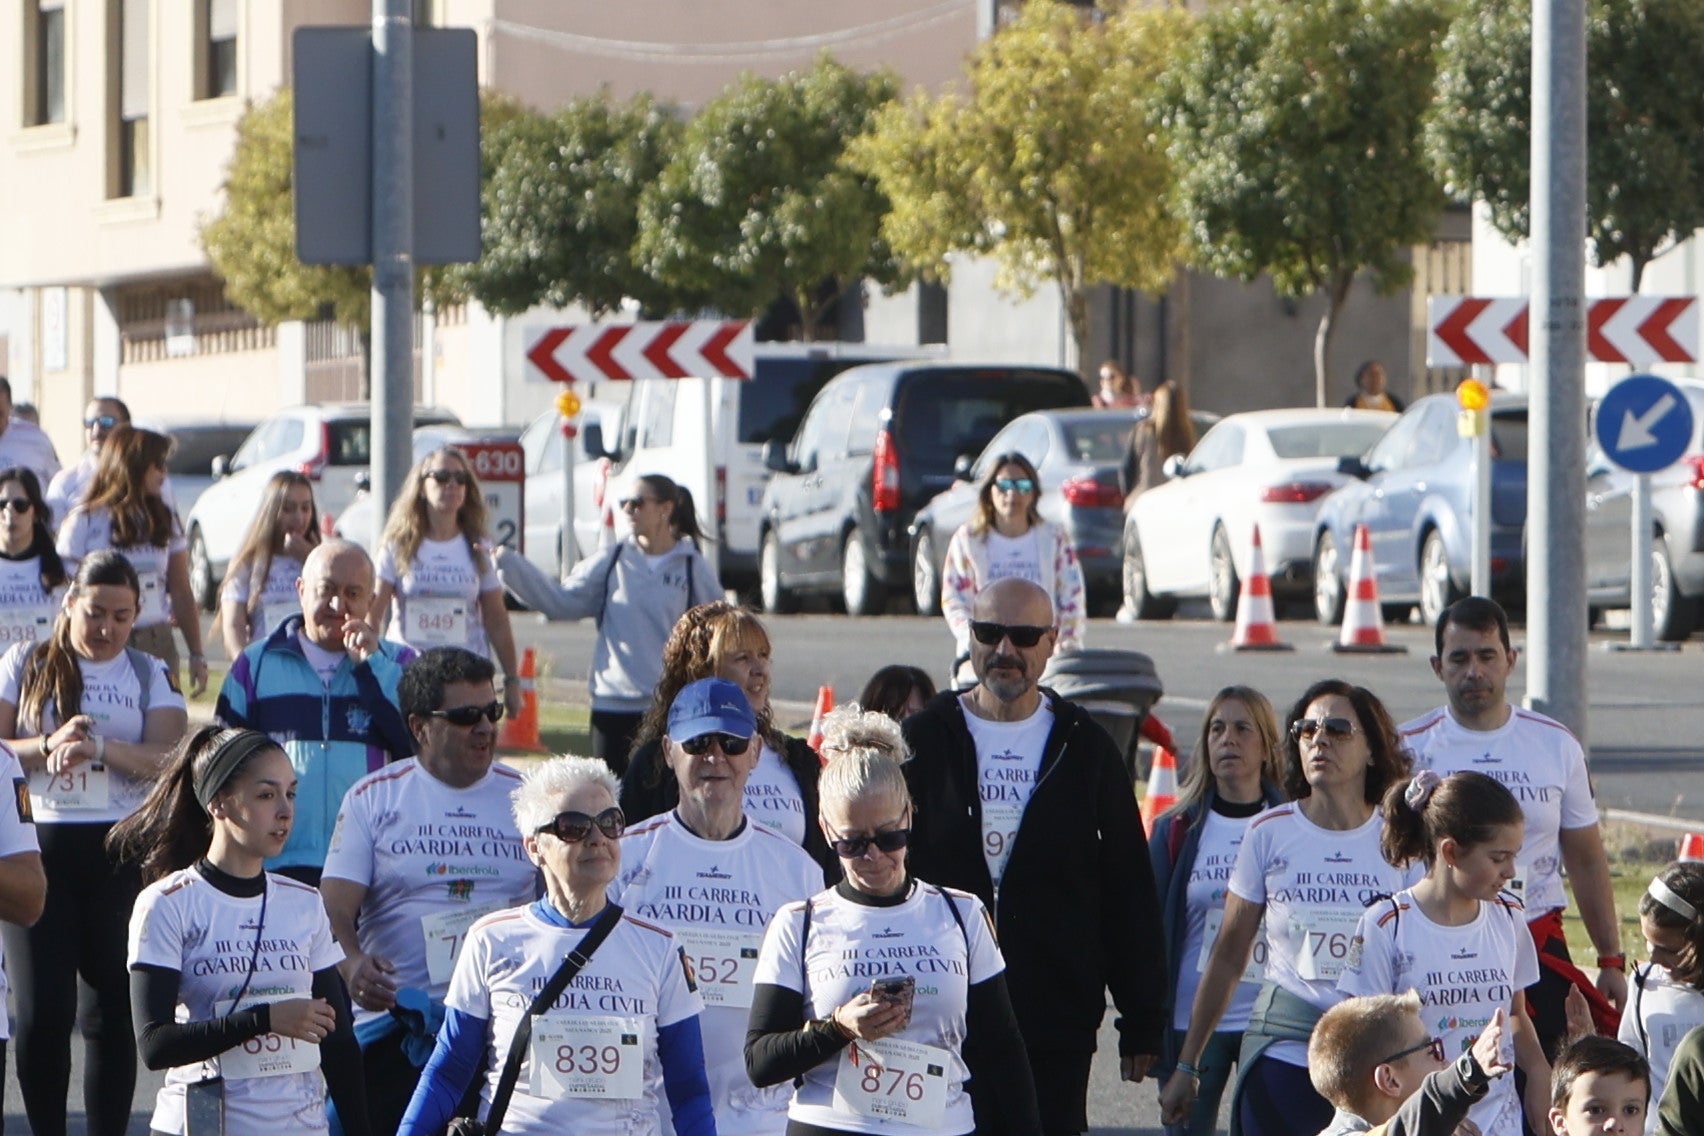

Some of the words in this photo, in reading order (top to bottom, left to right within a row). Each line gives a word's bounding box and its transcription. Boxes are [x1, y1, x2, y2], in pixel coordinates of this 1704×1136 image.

[418, 612, 454, 631] 849
[418, 823, 432, 837] III
[438, 824, 505, 840] CARRERA
[481, 841, 526, 862] CIVIL
[1296, 872, 1311, 884] III
[1316, 873, 1379, 887] CARRERA
[665, 885, 681, 899] III
[688, 886, 761, 906] CARRERA
[215, 940, 231, 954] III
[236, 938, 299, 954] CARRERA
[843, 947, 858, 960] III
[865, 944, 940, 959] CARRERA
[1309, 931, 1354, 959] 76
[915, 958, 966, 977] CIVIL
[1427, 973, 1442, 986] III
[1448, 968, 1508, 985] CARRERA
[567, 974, 624, 992] ARRERA
[598, 995, 648, 1014] CIVIL
[1419, 986, 1480, 1007] VARDIA
[555, 1045, 620, 1075] 839
[861, 1064, 924, 1101] 876
